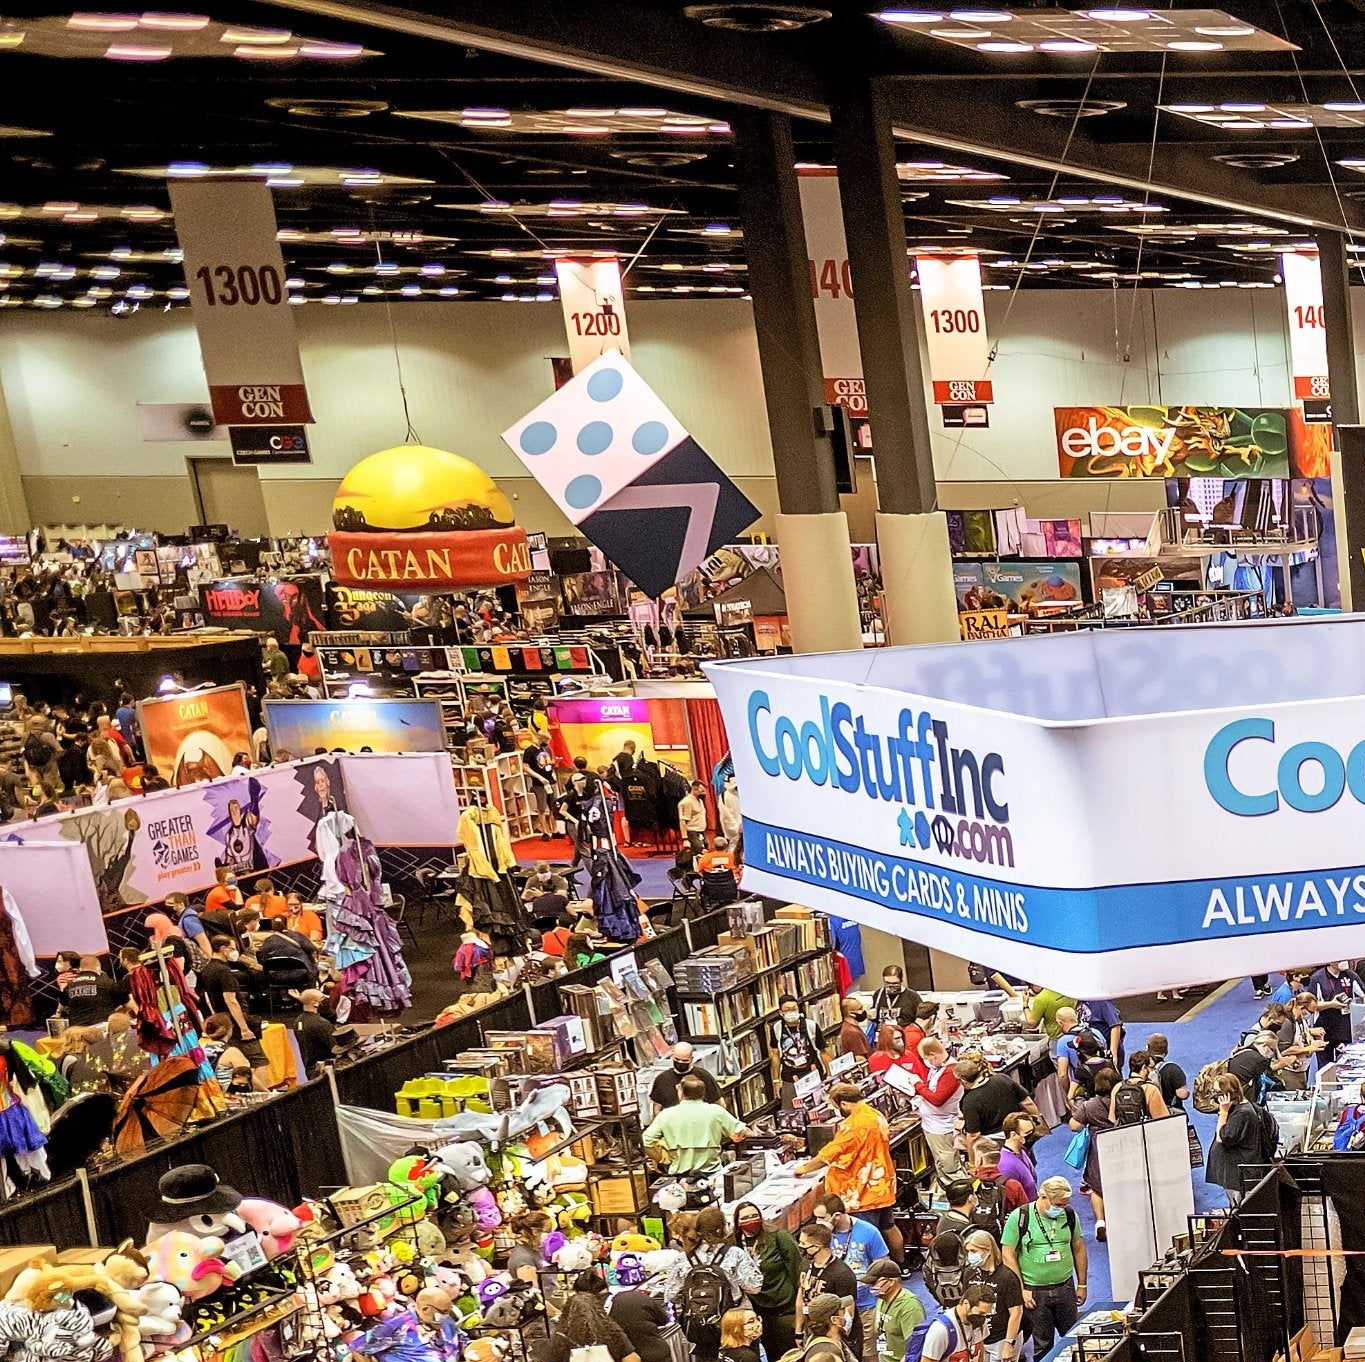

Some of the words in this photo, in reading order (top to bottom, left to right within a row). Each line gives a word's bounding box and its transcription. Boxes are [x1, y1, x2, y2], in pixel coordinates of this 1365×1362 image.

[196, 264, 281, 305] 1300
[571, 312, 621, 336] 1200
[930, 309, 980, 334] 1300
[239, 387, 281, 401] GEN
[241, 402, 283, 418] CON
[1061, 417, 1177, 465] ebay
[347, 546, 452, 580] CATAN
[178, 701, 209, 720] CATAN
[748, 689, 1010, 825] CoolStuffInc
[147, 815, 194, 841] GREATER
[168, 831, 197, 850] THAN
[170, 845, 199, 866] GAMES
[765, 832, 828, 879] ALWAYS
[829, 849, 890, 898] BUYING
[892, 864, 954, 915] CARDS
[957, 883, 971, 914] &
[973, 888, 1029, 933] MINIS
